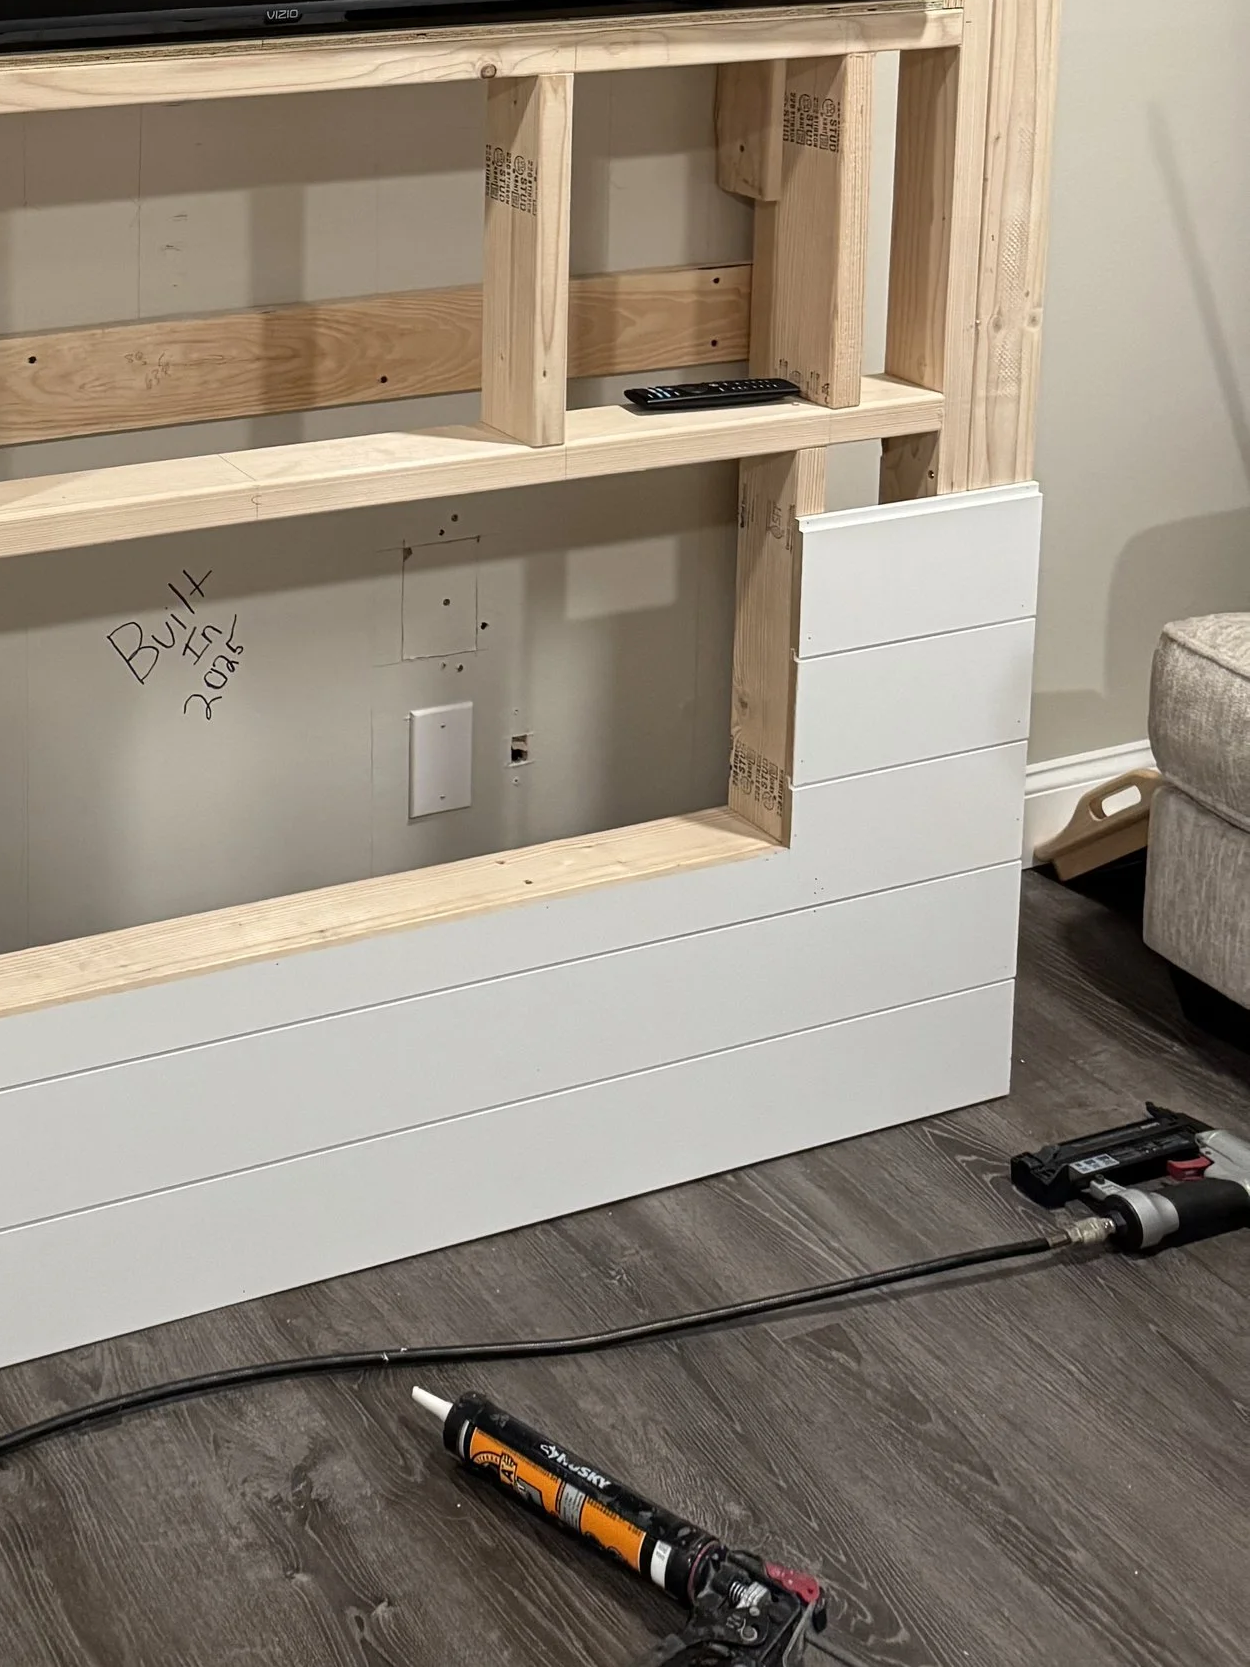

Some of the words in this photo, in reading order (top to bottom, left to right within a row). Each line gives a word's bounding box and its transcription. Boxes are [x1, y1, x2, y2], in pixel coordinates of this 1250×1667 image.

[266, 9, 299, 20] VIZIO
[805, 114, 814, 147] STUD
[829, 119, 838, 153] STUD
[520, 177, 528, 212] STUD
[106, 569, 213, 685] Built
[182, 624, 223, 666] In
[183, 613, 244, 721] 2025
[761, 758, 769, 790] STUD
